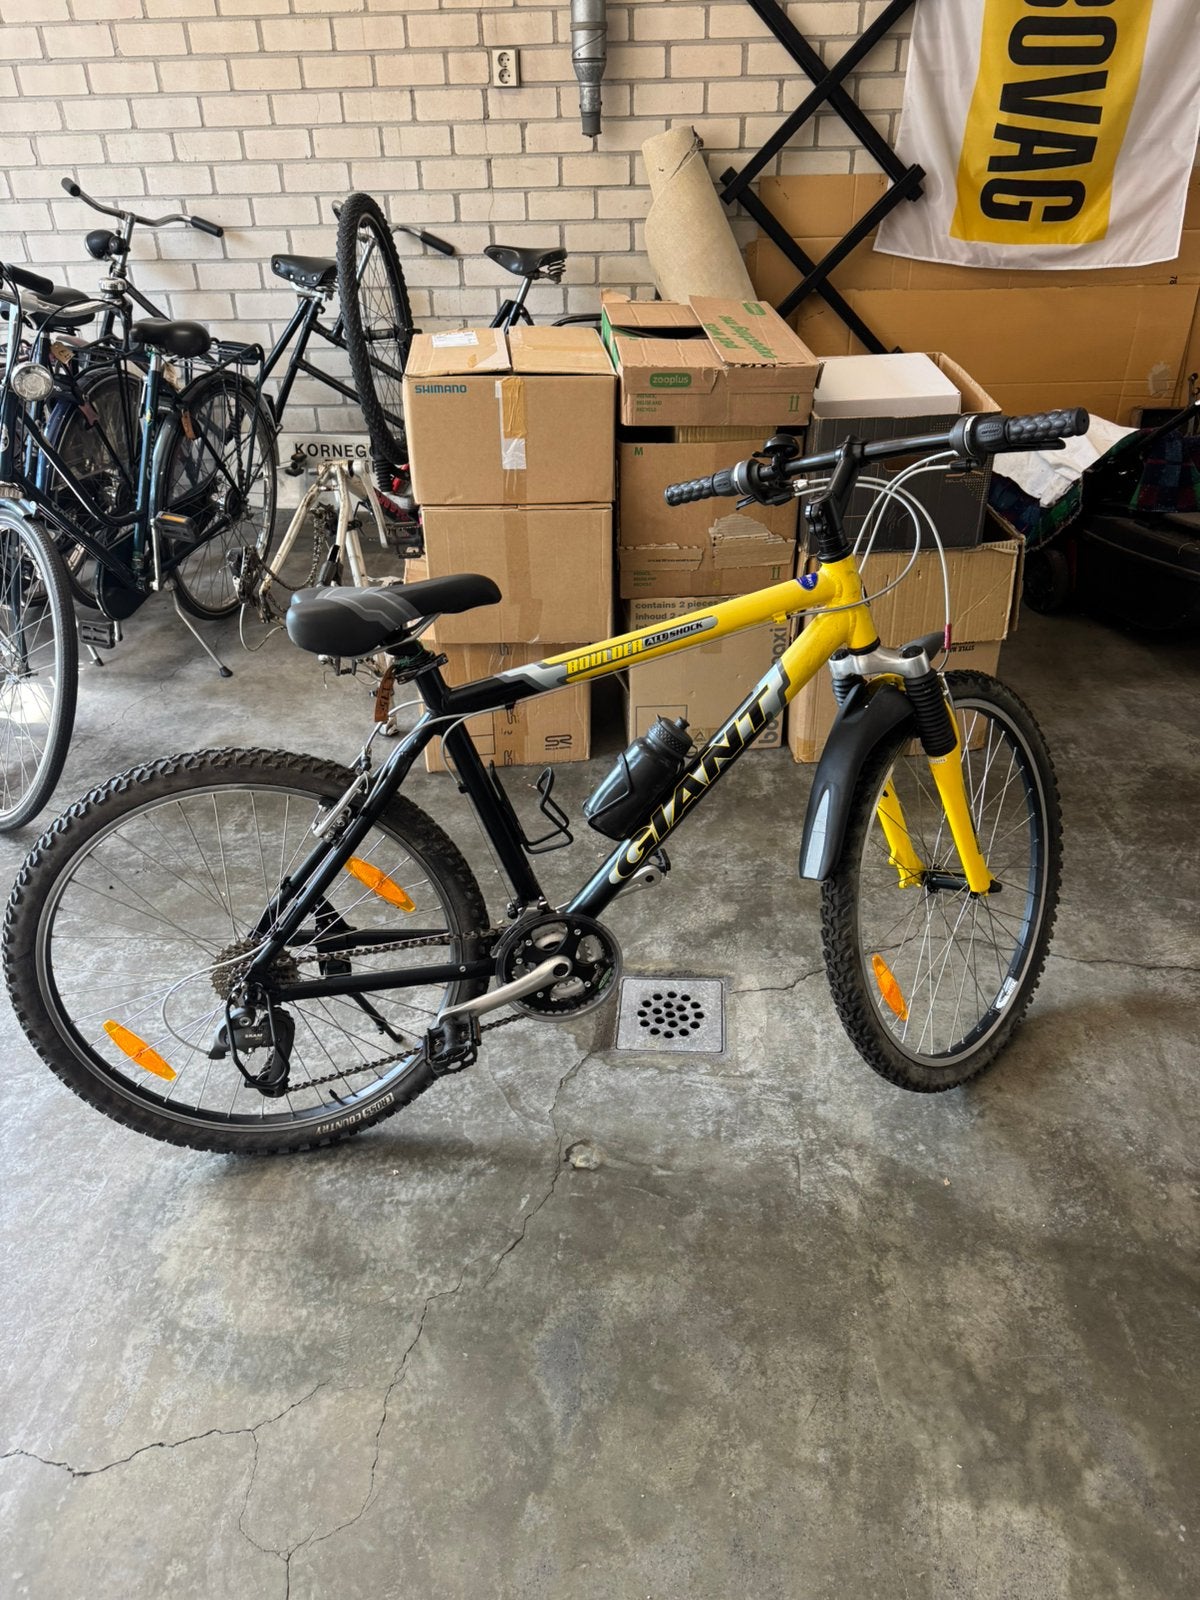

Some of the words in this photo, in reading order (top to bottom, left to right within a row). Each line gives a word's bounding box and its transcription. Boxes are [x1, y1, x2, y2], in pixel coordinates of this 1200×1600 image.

[980, 0, 1117, 222] OVAG
[653, 375, 689, 386] zooplus
[415, 384, 467, 394] SHIMANO
[294, 442, 372, 458] KORNEG
[634, 446, 644, 456] M
[635, 601, 676, 609] contains
[679, 600, 685, 608] 2
[635, 612, 667, 620] inhoud
[566, 638, 643, 674] BOULDER
[616, 684, 770, 879] GIANT
[364, 1094, 394, 1117] CROSS
[315, 1112, 362, 1136] COUNTRY
